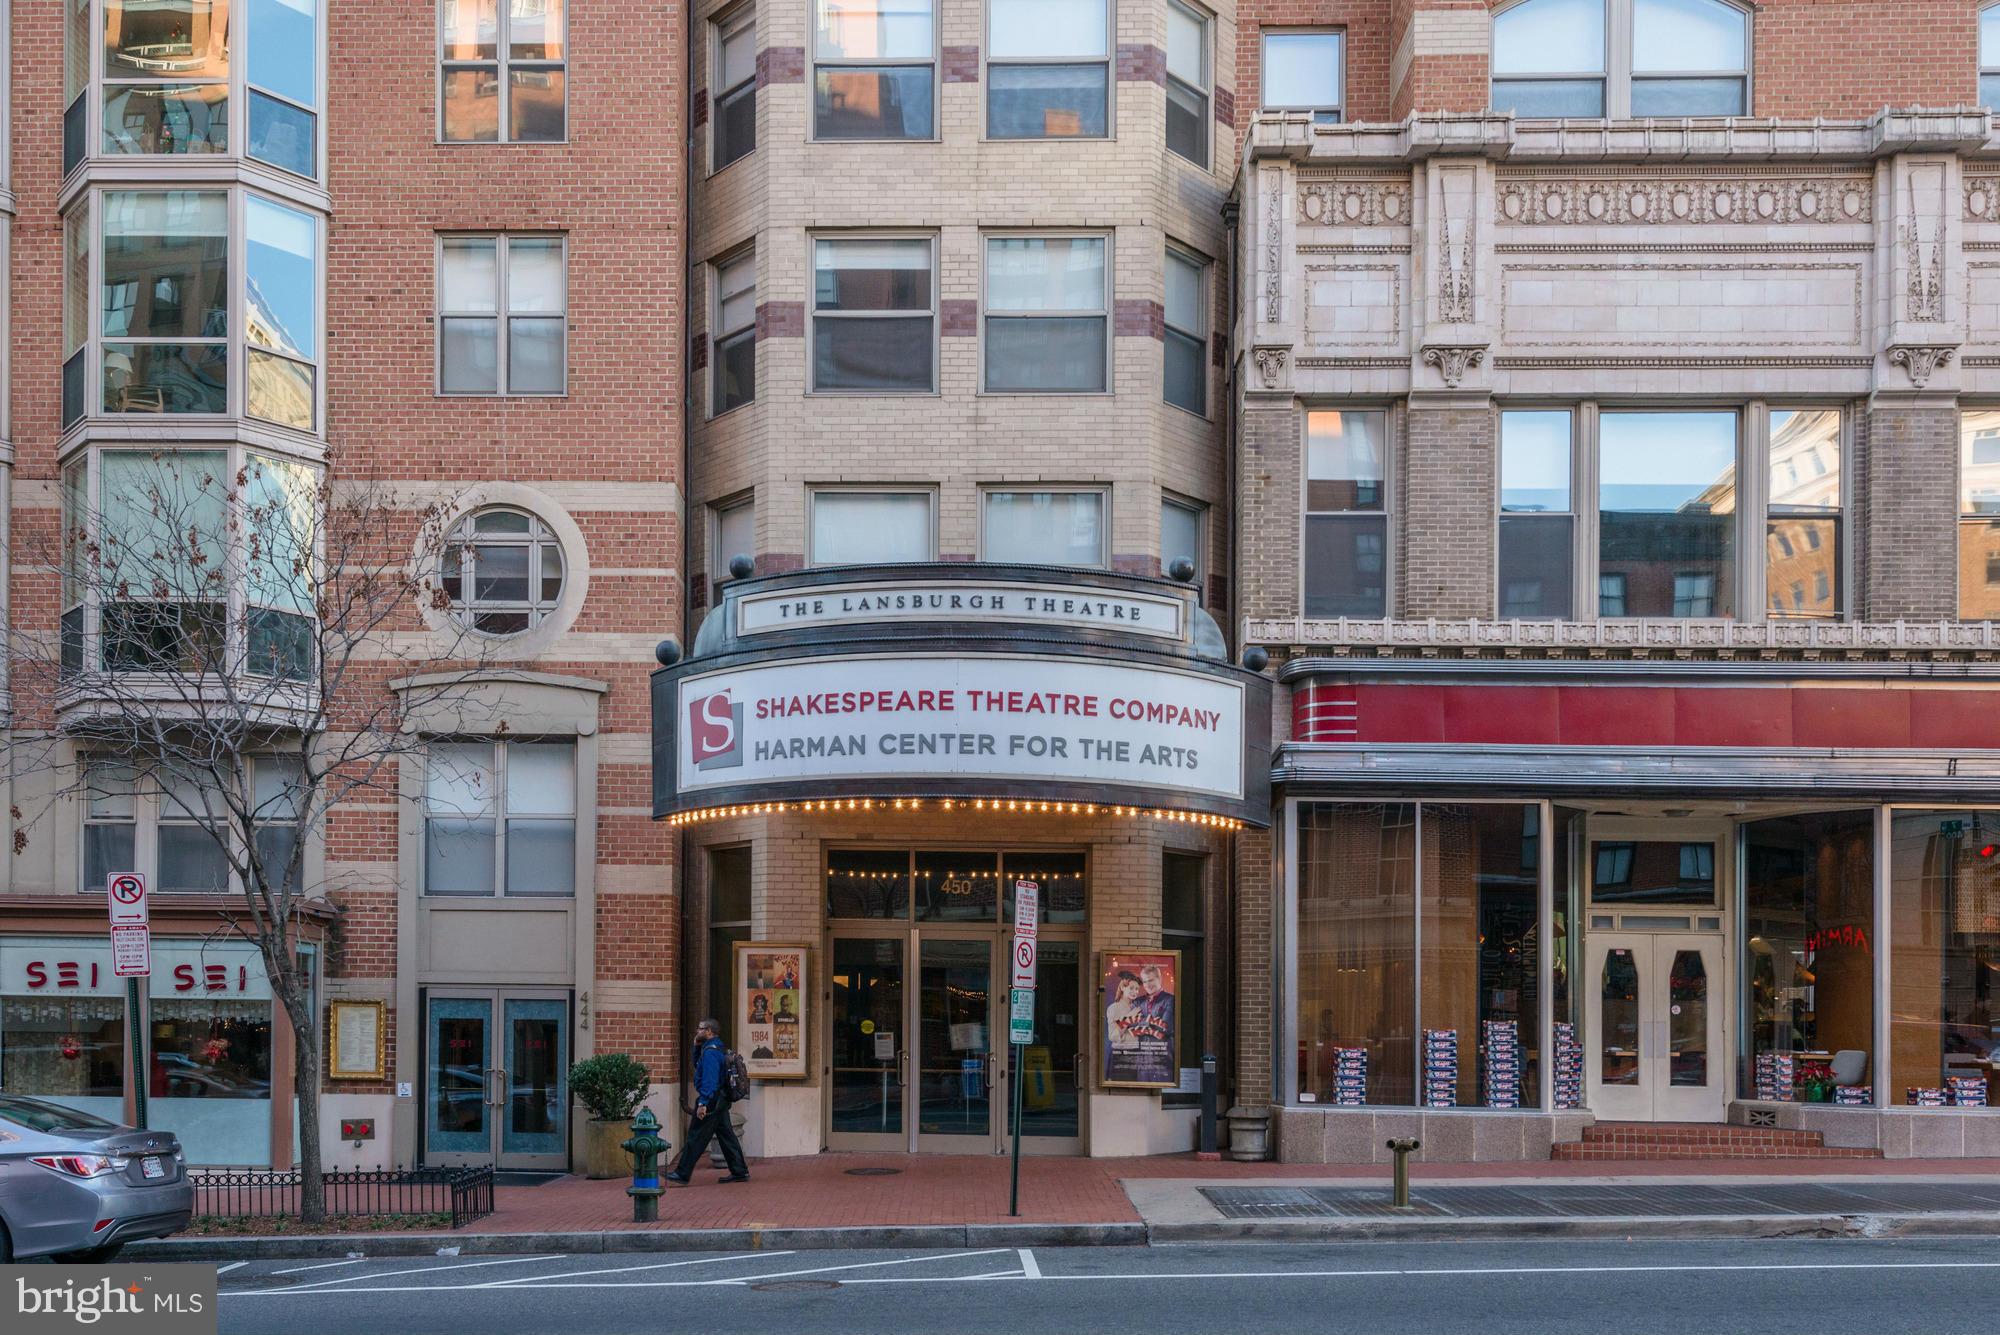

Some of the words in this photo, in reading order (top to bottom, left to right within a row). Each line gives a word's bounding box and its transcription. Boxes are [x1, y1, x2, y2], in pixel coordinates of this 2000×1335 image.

[778, 599, 824, 619] THE
[842, 594, 1006, 612] LANSBURGH
[1024, 595, 1142, 622] THEATRE
[755, 689, 955, 720] SHAKESPEARE
[967, 690, 1099, 718] THEATRE
[1108, 697, 1222, 732] COMPANY
[754, 733, 867, 762] HARMAN
[877, 732, 997, 756] CENTER
[1008, 734, 1069, 760] FOR
[1078, 738, 1130, 763] THE
[1138, 743, 1199, 770] ARTS
[940, 879, 971, 895] 450
[26, 961, 98, 988] SEI
[174, 964, 246, 991] SEI
[1013, 991, 1018, 1002] 2
[580, 991, 590, 1030] 444
[751, 1031, 769, 1042] 1984
